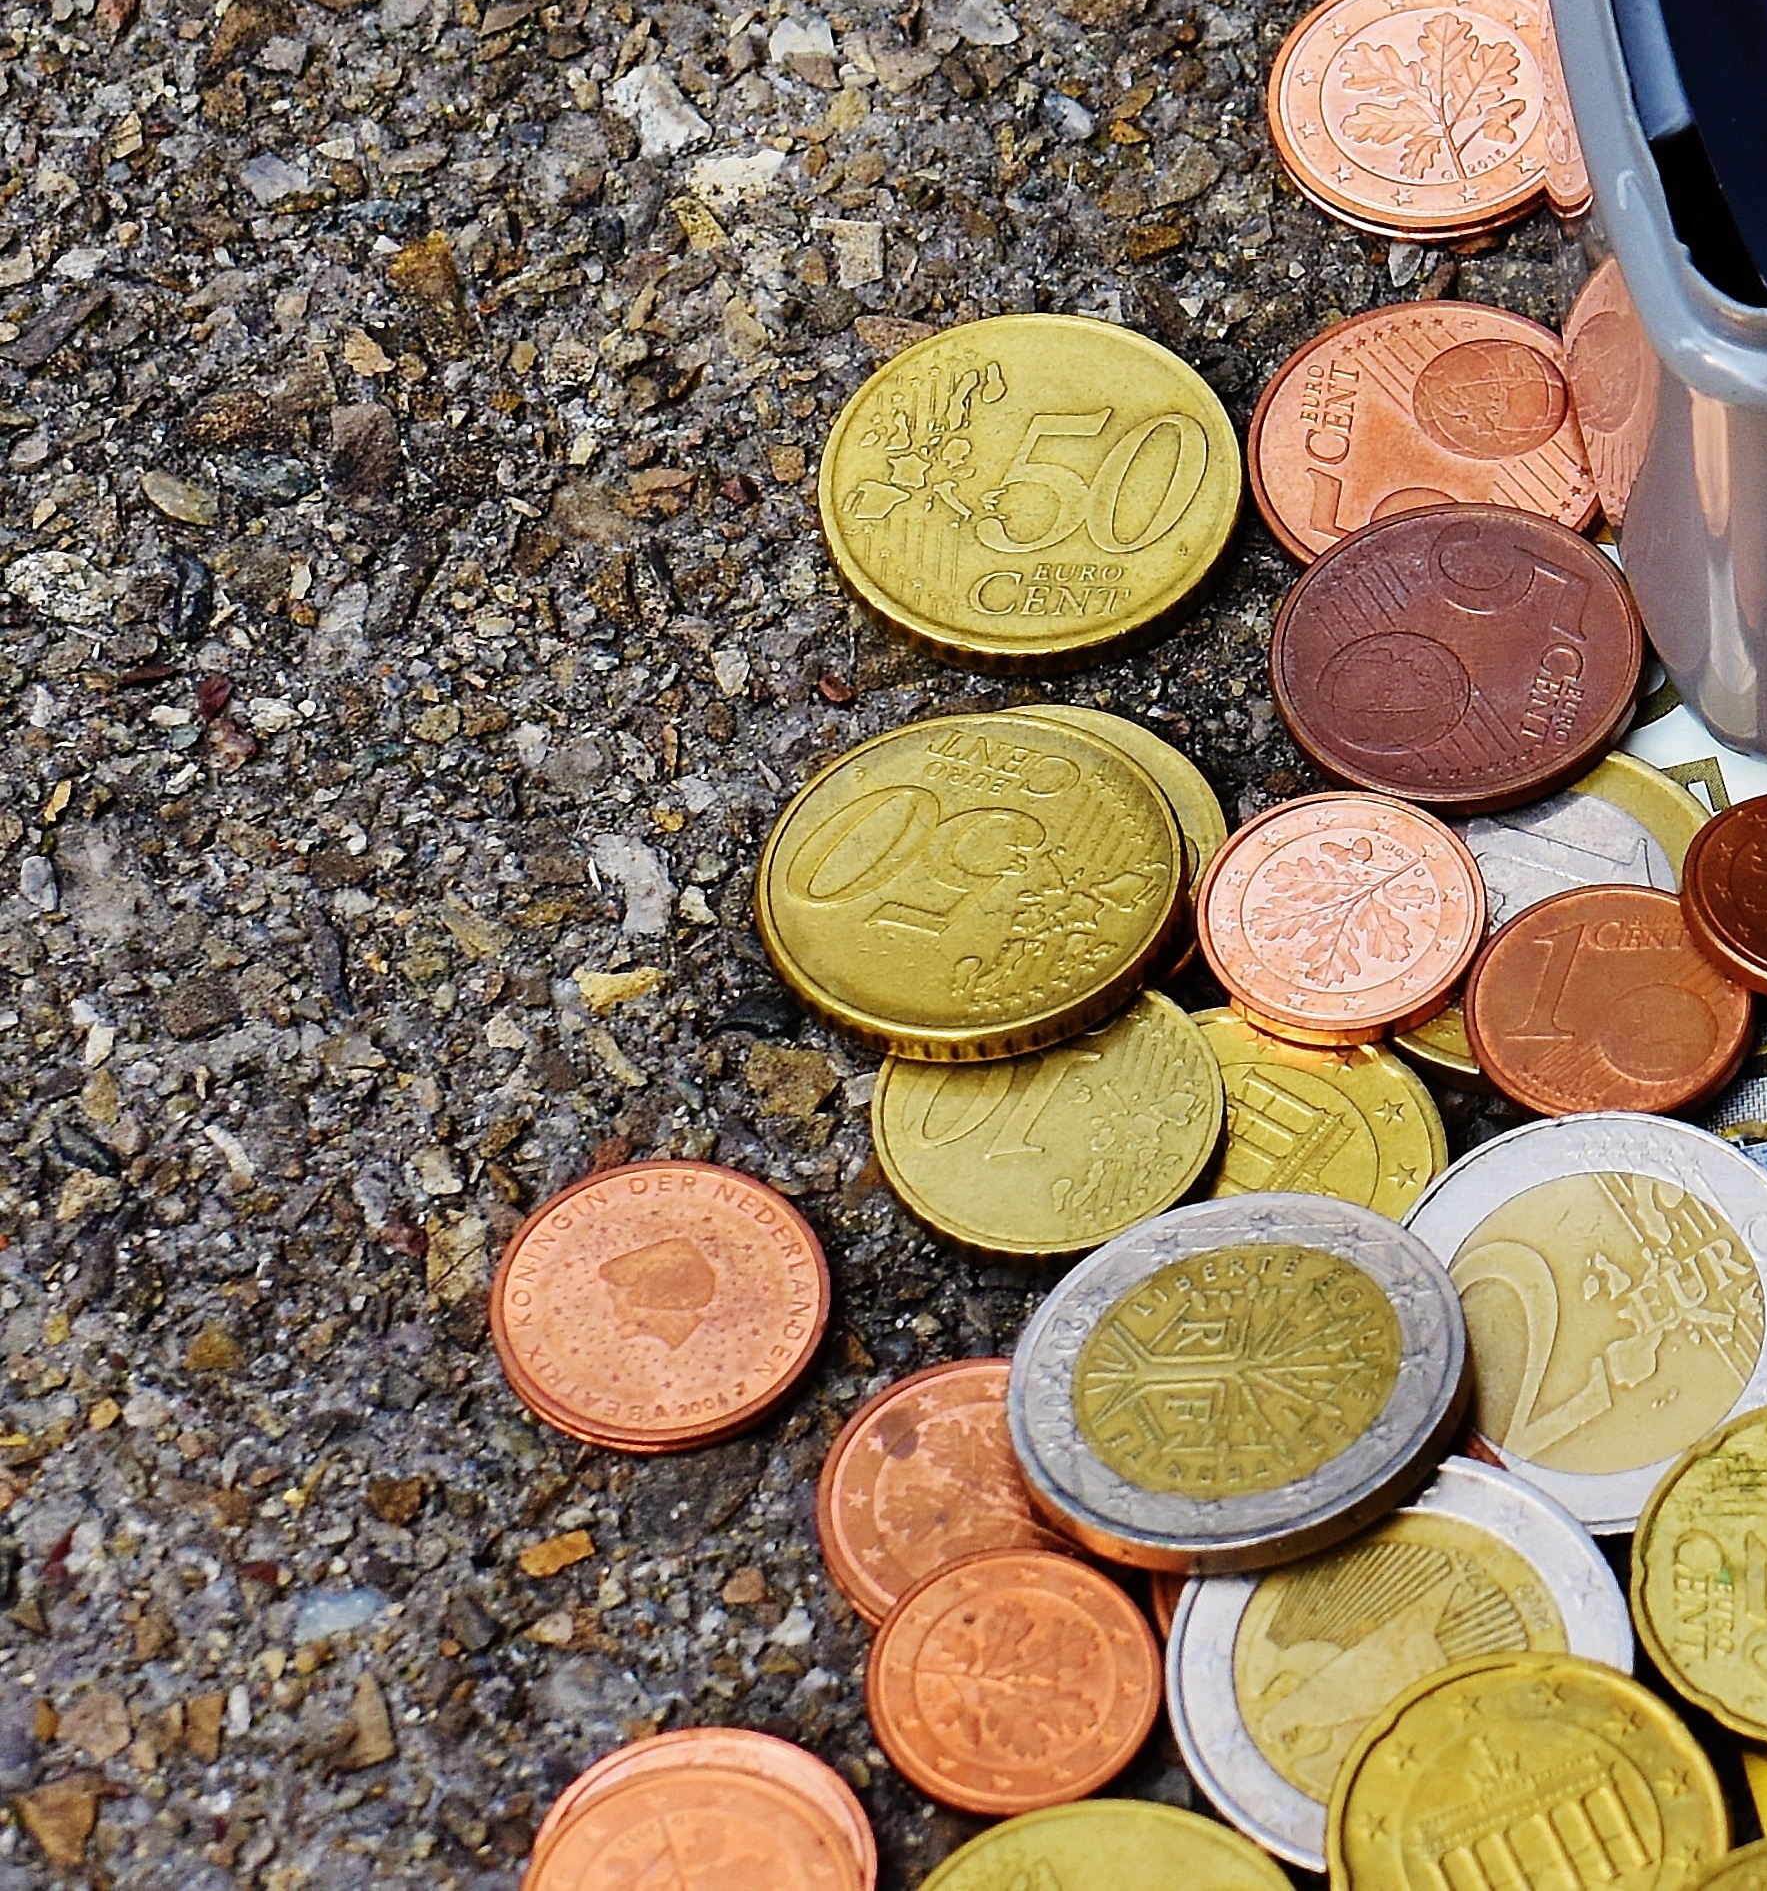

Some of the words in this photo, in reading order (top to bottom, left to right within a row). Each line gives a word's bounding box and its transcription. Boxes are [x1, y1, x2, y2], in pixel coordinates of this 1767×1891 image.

[1300, 363, 1325, 424] EURO
[1304, 360, 1362, 466] CENT
[972, 406, 1209, 555] 50
[967, 568, 1133, 617] CENT
[1029, 561, 1126, 583] EURO
[1428, 520, 1593, 645] 5
[1519, 641, 1585, 750] CENT
[1552, 677, 1586, 747] EURO
[922, 759, 1014, 797] EURO
[924, 728, 1082, 799] CENT
[785, 782, 1048, 939] 50
[1506, 923, 1586, 1040] 1
[509, 1187, 608, 1329] KONINGIN
[628, 1173, 697, 1197] DER
[711, 1182, 812, 1379] NEDERLANDEN
[1449, 1240, 1613, 1465] 2
[1673, 1528, 1731, 1660] CENT
